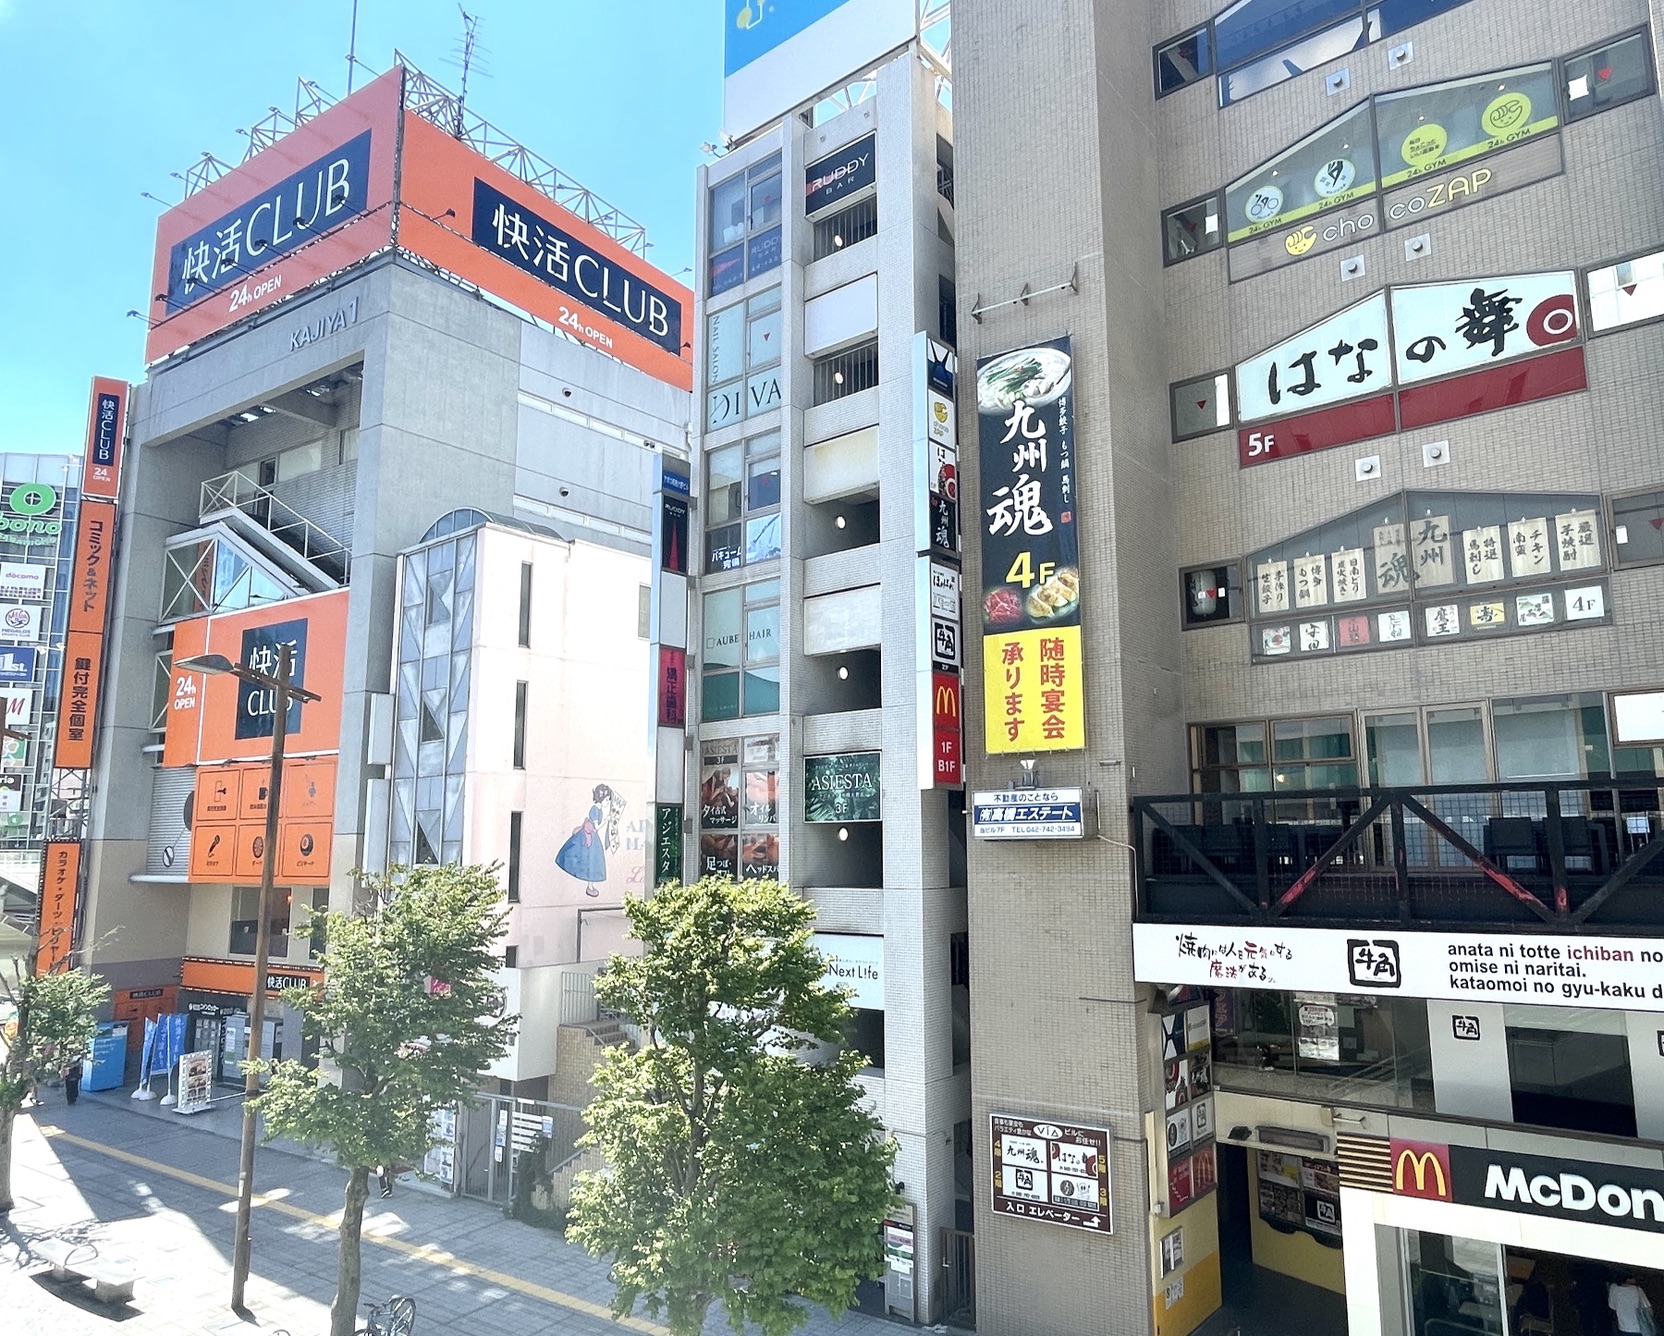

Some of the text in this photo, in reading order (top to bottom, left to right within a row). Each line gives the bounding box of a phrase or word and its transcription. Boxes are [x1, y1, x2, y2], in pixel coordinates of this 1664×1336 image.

[1505, 128, 1531, 143] GYM
[811, 153, 869, 192] RUDDY
[1423, 158, 1447, 173] GYM
[825, 177, 854, 195] BAR
[1334, 192, 1355, 205] GYM
[182, 158, 350, 293] 快活CLUB
[1264, 215, 1282, 230] GYM
[492, 203, 669, 336] 快活CLUB
[254, 275, 282, 301] OPEN
[290, 308, 346, 352] KAJIYA
[585, 325, 613, 349] OPEN
[1268, 288, 1523, 405] はなの舞
[99, 399, 116, 461] 快活CLUB
[1247, 432, 1275, 457] 5F
[987, 399, 1053, 537] 九州魂
[935, 500, 950, 548] 九州魂
[1416, 520, 1448, 567] 九州
[1530, 529, 1543, 565] チキン
[5, 572, 39, 581] docomo
[1005, 552, 1057, 589] 4F
[1573, 596, 1596, 613] 4F
[715, 628, 772, 647] AUBE HAIR
[175, 675, 197, 698] 24h
[1002, 642, 1025, 742] 承ります
[1040, 637, 1066, 741] 随時宴会
[173, 698, 196, 711] OPEN
[941, 741, 953, 754] 1F
[938, 758, 956, 773] B1F
[811, 772, 873, 791] ASIESTA
[835, 802, 848, 814] 3F
[993, 792, 1059, 804] 不動産のことなら
[660, 807, 672, 874] アジエスタ
[1448, 943, 1664, 963] anata ni totte ichiban no
[829, 963, 856, 978] Next
[1449, 959, 1587, 978] omise ni naritai.
[1450, 974, 1527, 992] kataomoi
[1533, 981, 1555, 993] no
[1561, 981, 1646, 1000] gyu-kaku
[1007, 1201, 1081, 1222] 入口 エレベーター
